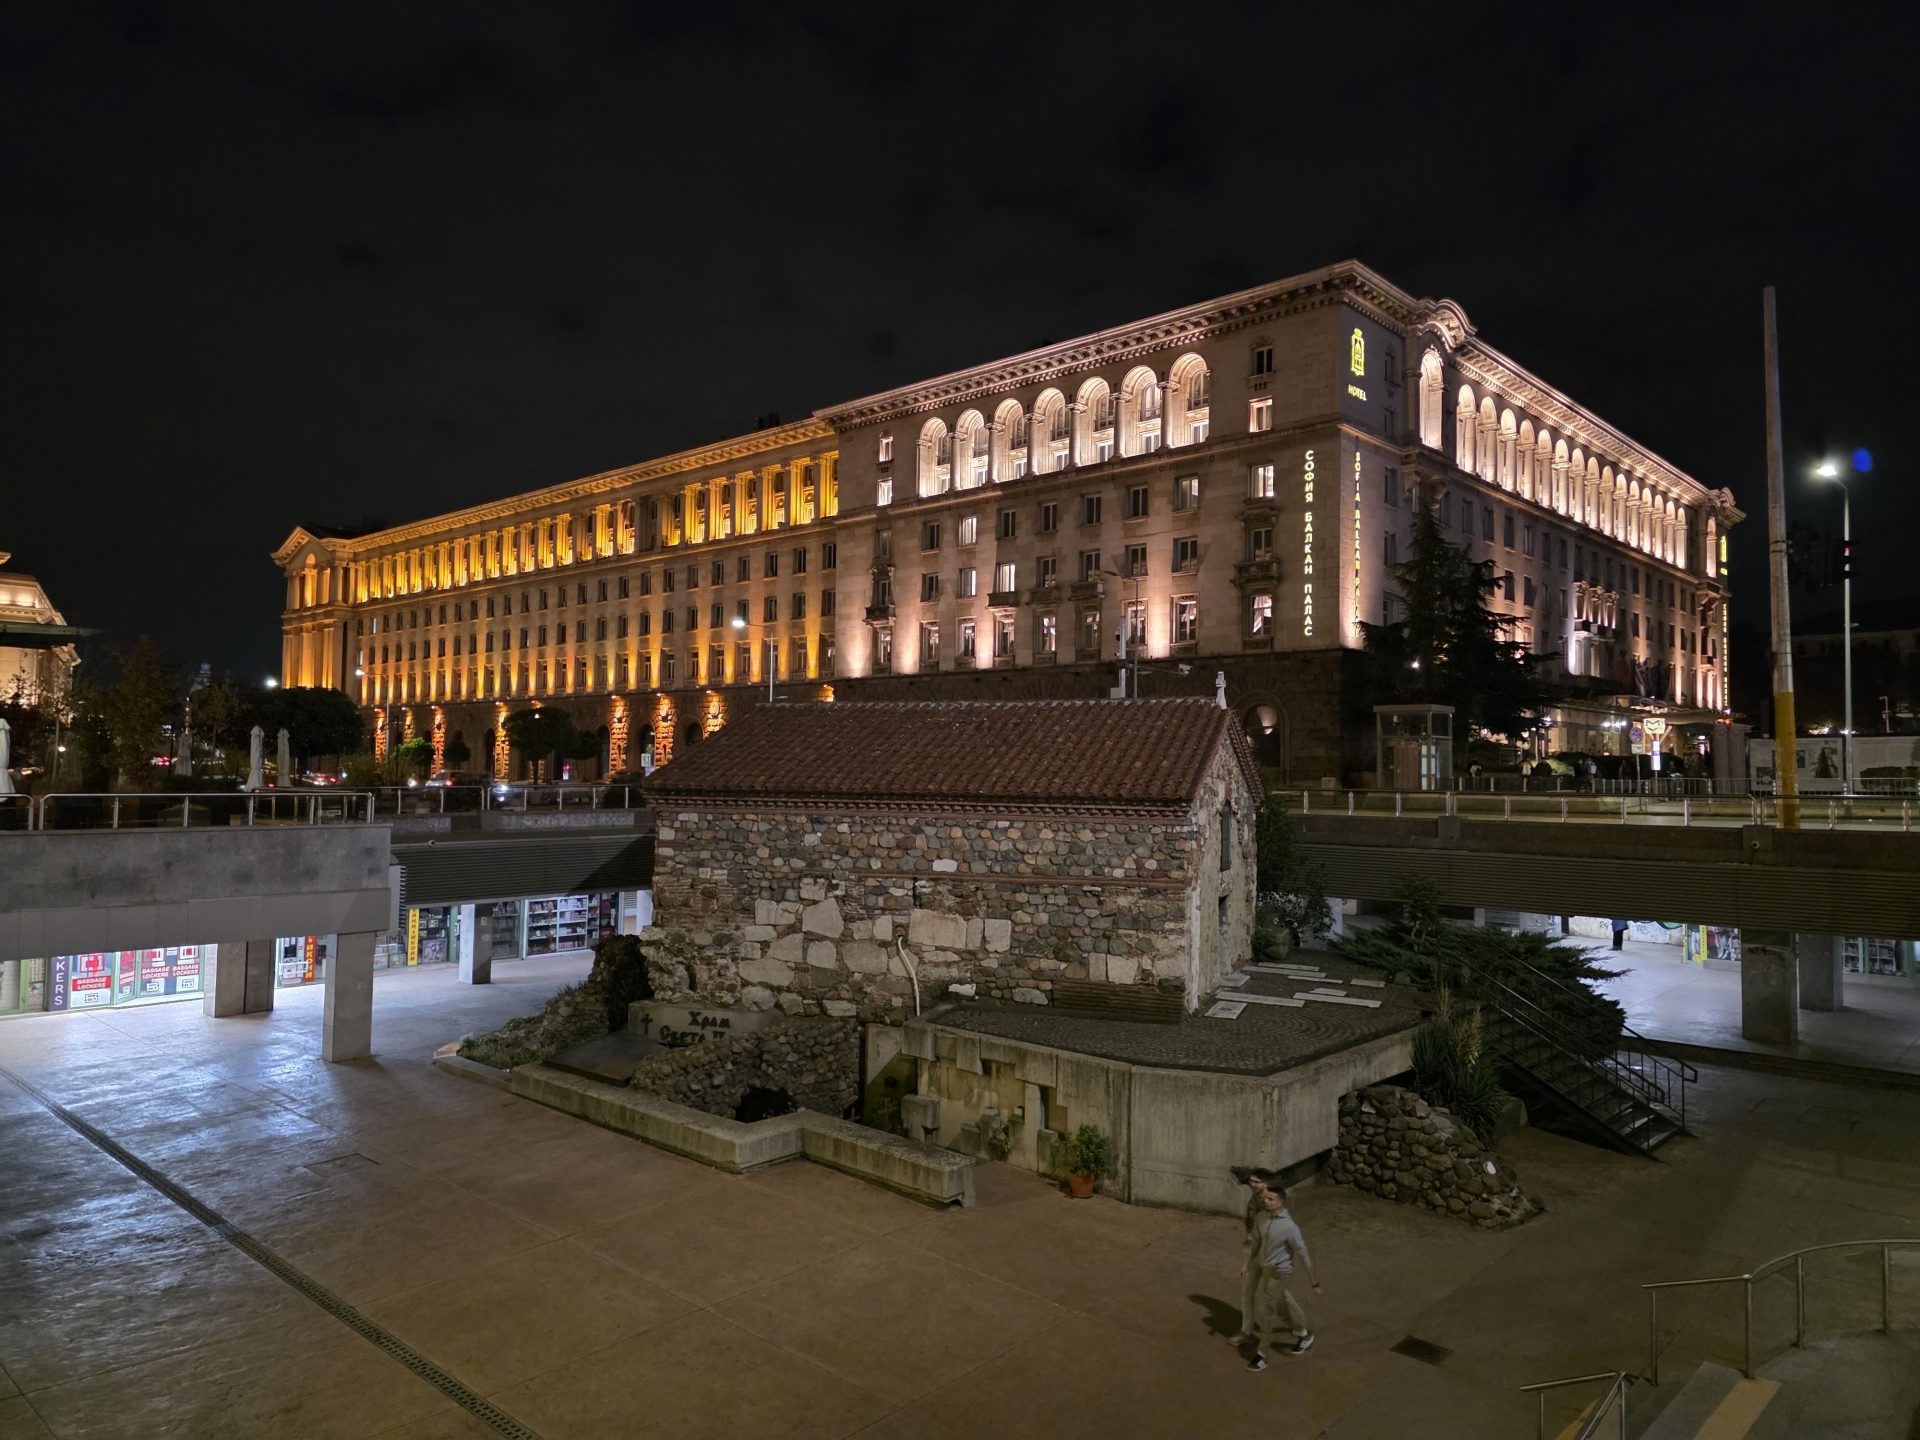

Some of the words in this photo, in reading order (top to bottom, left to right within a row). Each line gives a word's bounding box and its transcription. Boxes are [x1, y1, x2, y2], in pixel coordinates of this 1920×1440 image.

[1347, 384, 1367, 401] HOTEL
[1304, 450, 1314, 503] СОФИЯ
[1304, 512, 1314, 575] БАЛКАН
[1304, 584, 1314, 636] ПАЛАС
[76, 977, 107, 985] BAGGAGE
[77, 982, 106, 990] LOCKERS
